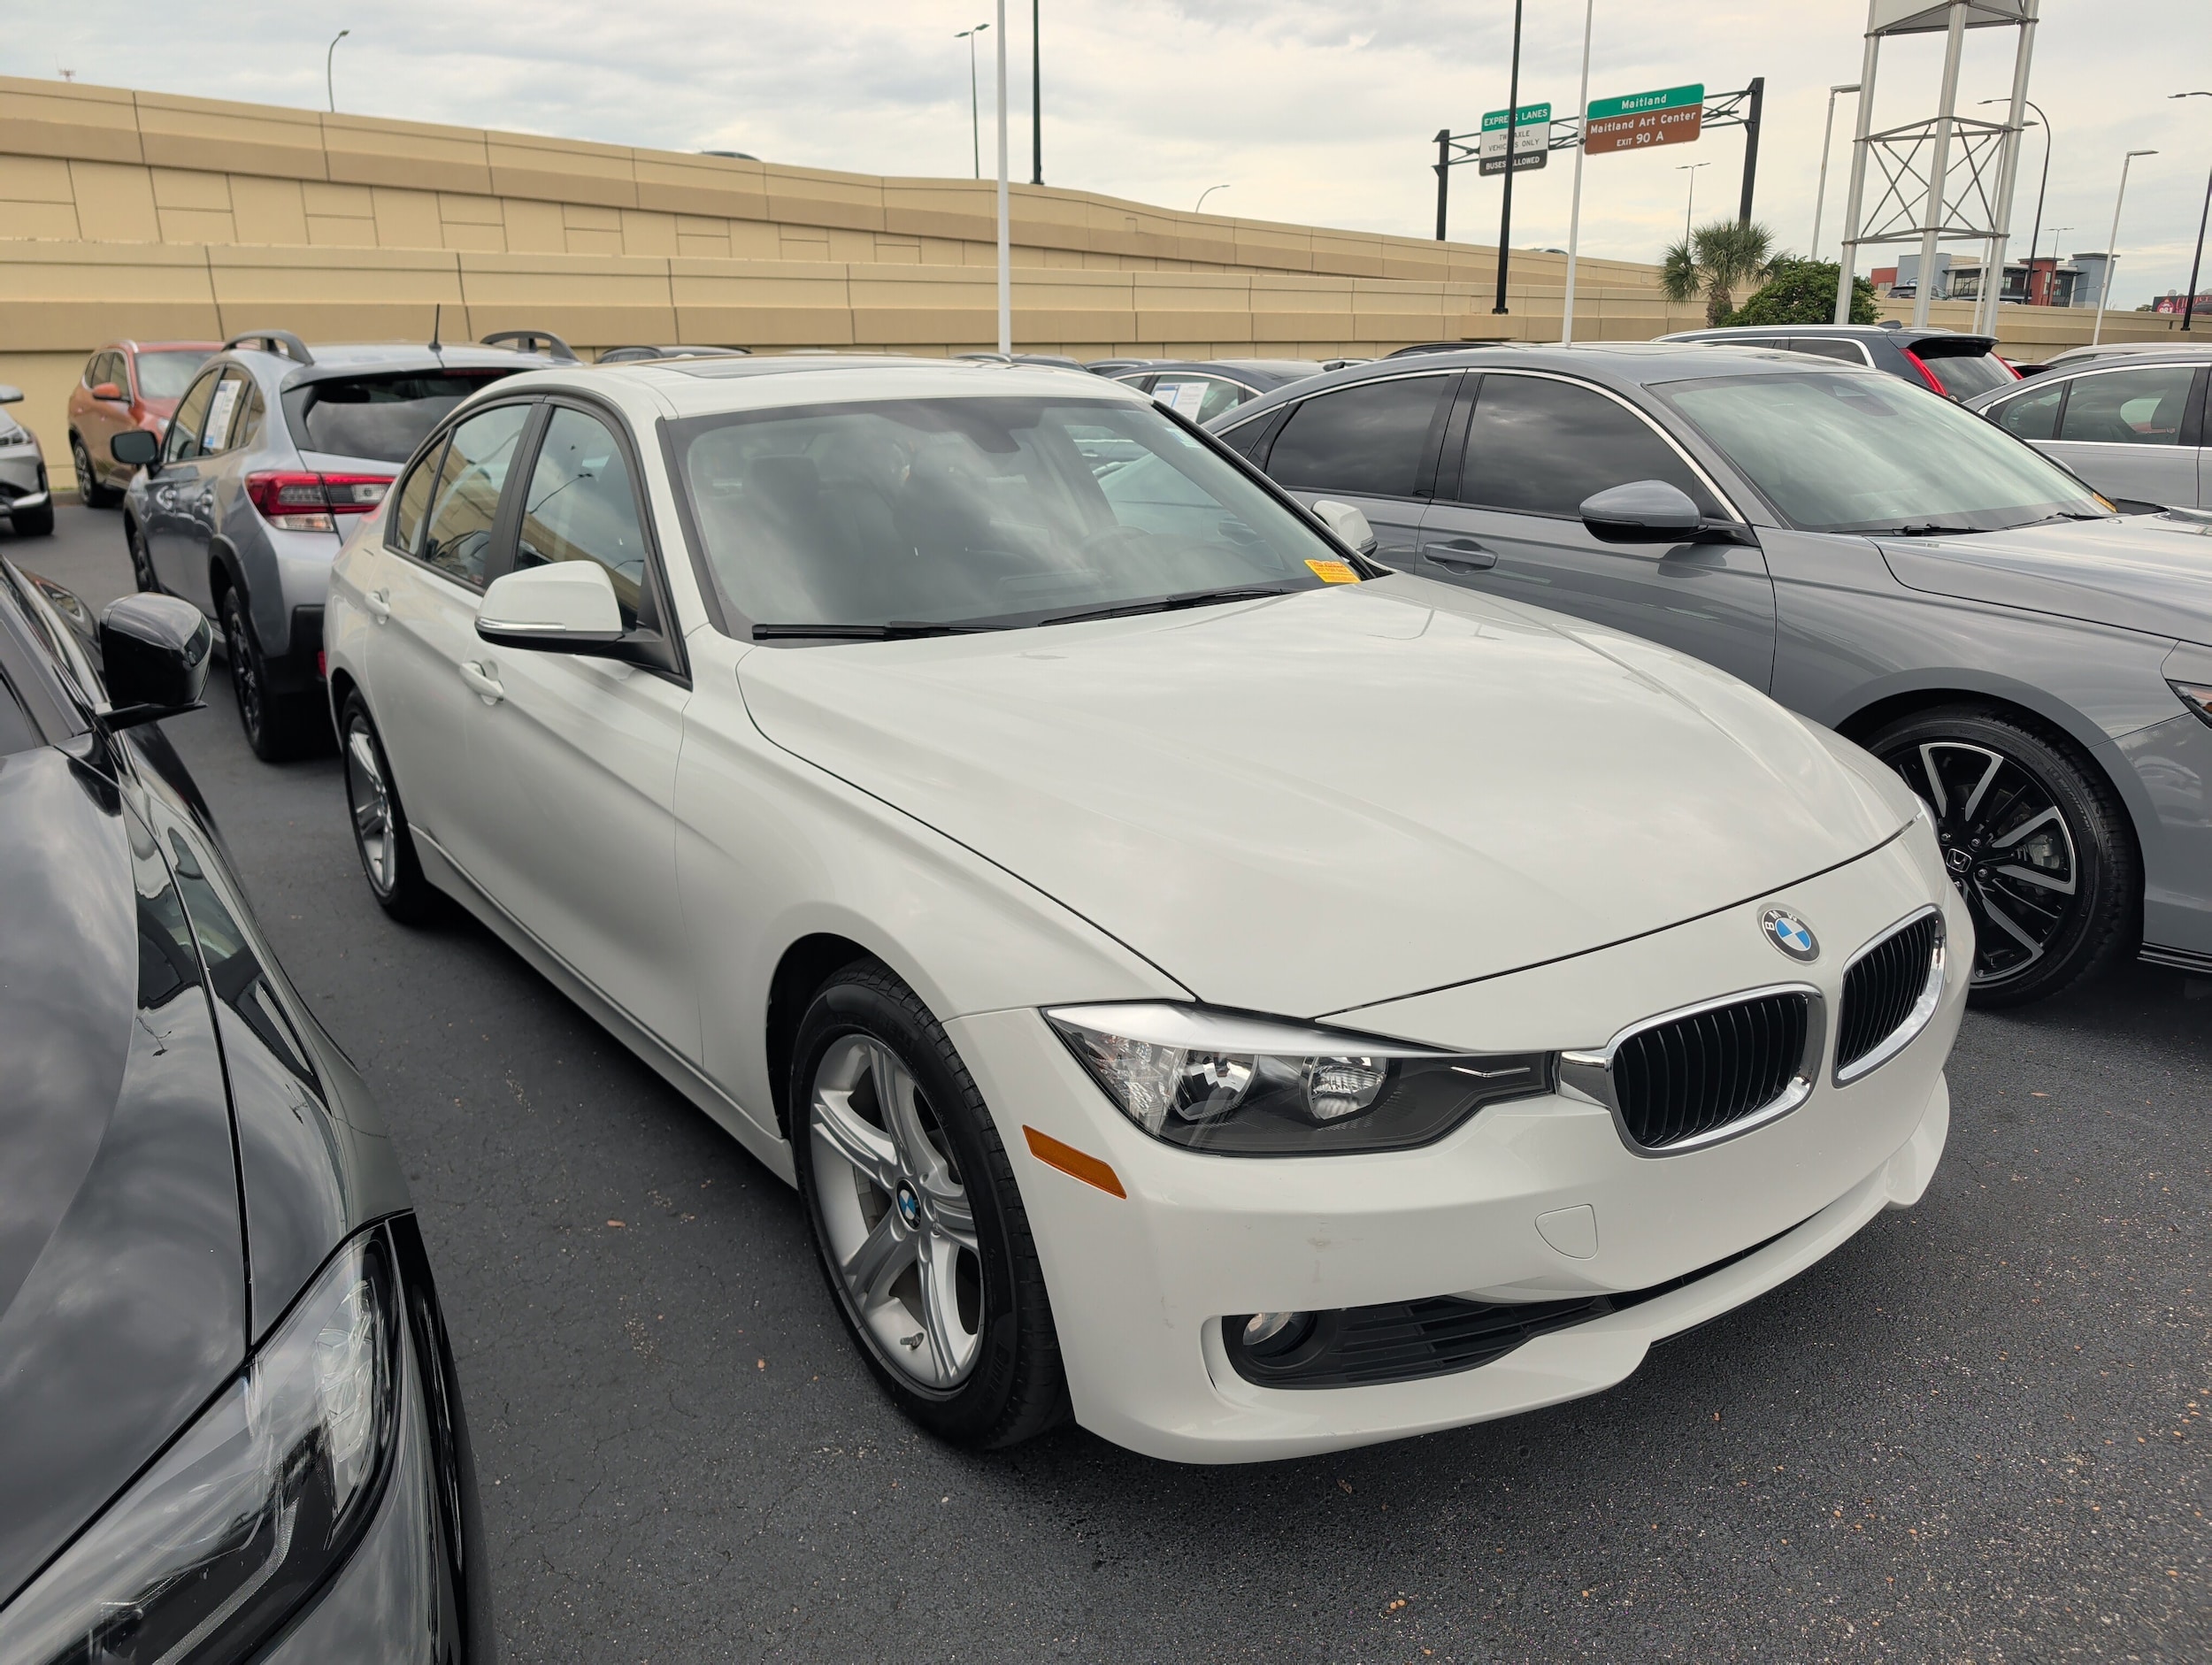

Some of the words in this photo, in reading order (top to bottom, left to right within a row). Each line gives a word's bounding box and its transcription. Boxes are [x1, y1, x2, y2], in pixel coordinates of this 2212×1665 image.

[1621, 94, 1667, 110] Maitland
[1484, 113, 1518, 127] EXPRES
[1522, 109, 1548, 120] LANES
[1590, 119, 1634, 134] Maitland
[1639, 116, 1655, 128] Art
[1660, 111, 1696, 124] Center
[1488, 142, 1519, 151] VEHICS
[1617, 138, 1633, 147] EXIT
[1636, 133, 1651, 144] 90
[1655, 131, 1664, 142] A
[1486, 161, 1507, 170] BUSES
[1764, 910, 1797, 931] BMW
